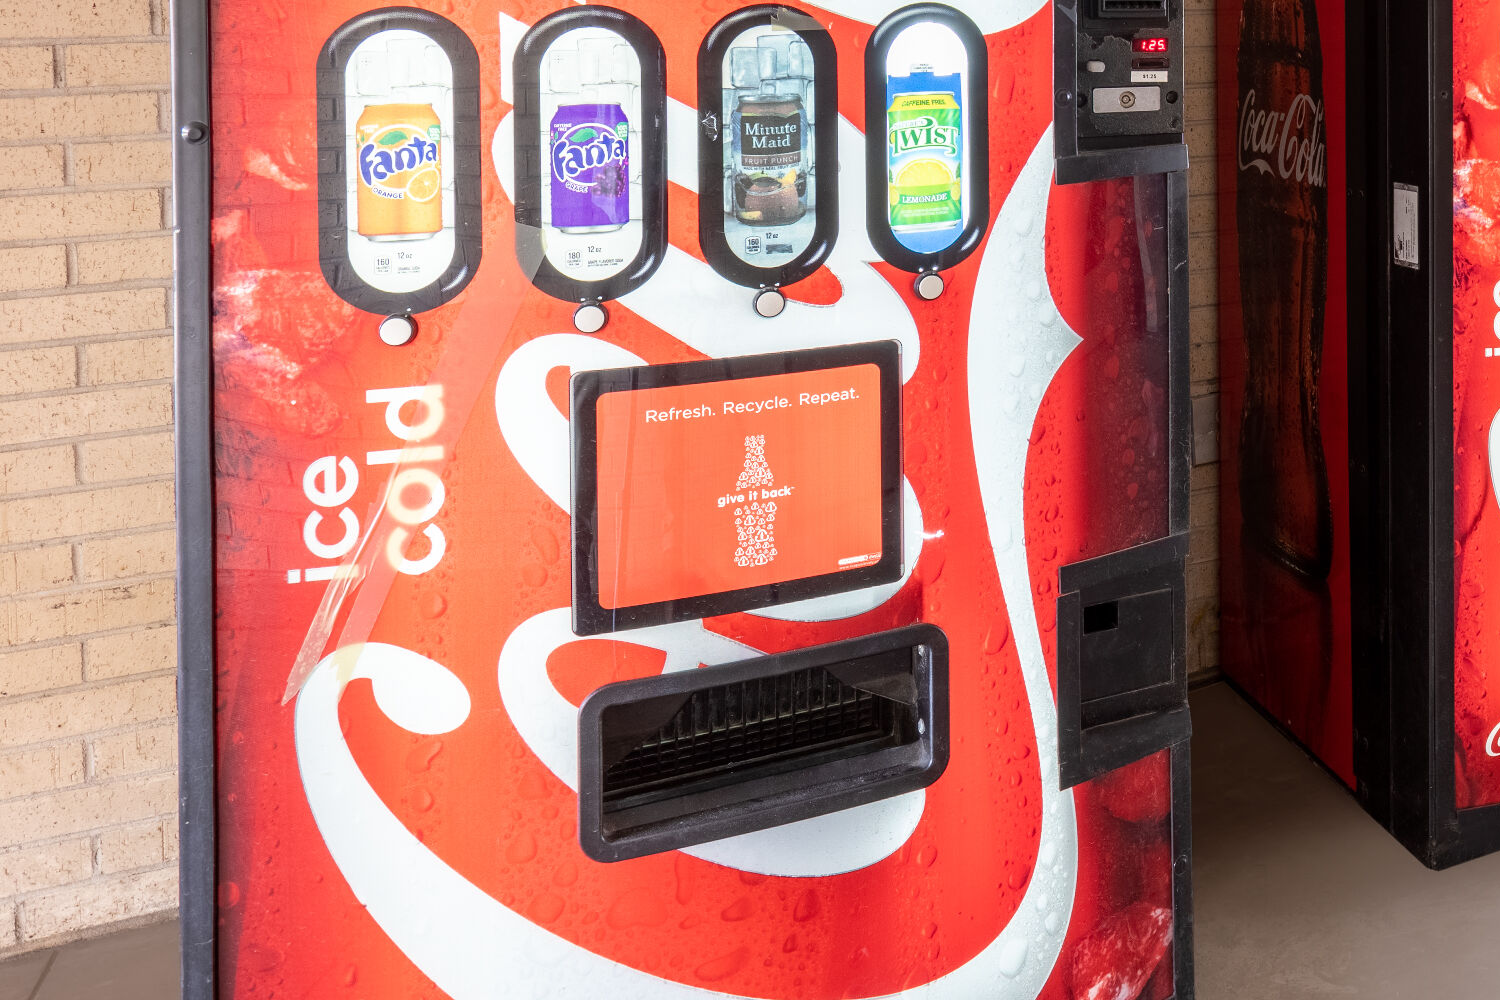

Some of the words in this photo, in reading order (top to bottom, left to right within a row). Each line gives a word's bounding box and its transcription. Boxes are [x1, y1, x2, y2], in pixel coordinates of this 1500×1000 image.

[745, 122, 797, 136] Minute
[889, 124, 958, 155] TWIST
[1238, 88, 1325, 188] Coca-Cola
[751, 134, 791, 149] Maid
[359, 136, 438, 186] Fanta
[554, 134, 625, 181] Fanta
[771, 155, 798, 164] PUNCH
[372, 187, 403, 199] ORANGE
[566, 182, 588, 193] GRAPE
[902, 193, 948, 204] LEMONADE
[568, 251, 581, 260] 180
[645, 404, 716, 423] Refresh.
[723, 396, 792, 415] Recycle.
[799, 387, 860, 407] Repeat.
[365, 383, 447, 576] cold
[717, 493, 745, 508] give
[748, 490, 758, 501] it
[761, 486, 791, 499] back
[287, 455, 359, 584] ice
